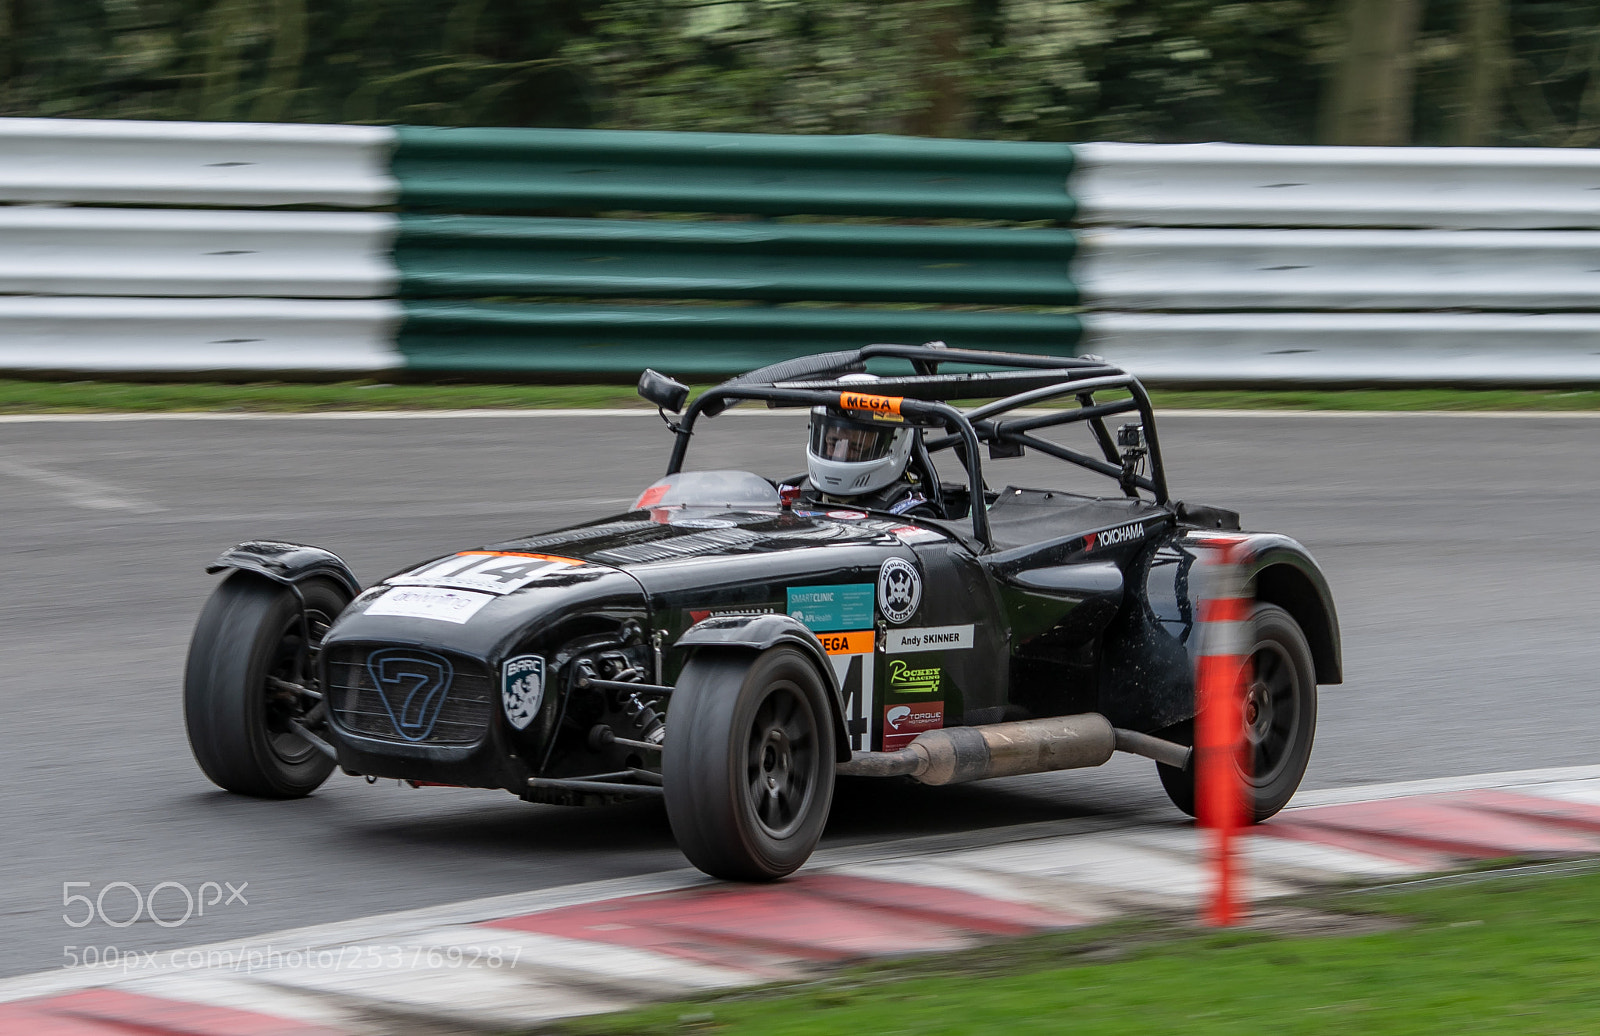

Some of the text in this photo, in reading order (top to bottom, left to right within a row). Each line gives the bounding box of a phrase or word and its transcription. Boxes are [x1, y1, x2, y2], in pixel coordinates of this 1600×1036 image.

[847, 396, 891, 410] MEGA
[1098, 522, 1145, 547] YOKOHAMA
[884, 604, 914, 620] RACING
[901, 633, 960, 646] Andy SKINNER
[507, 659, 541, 676] BARC
